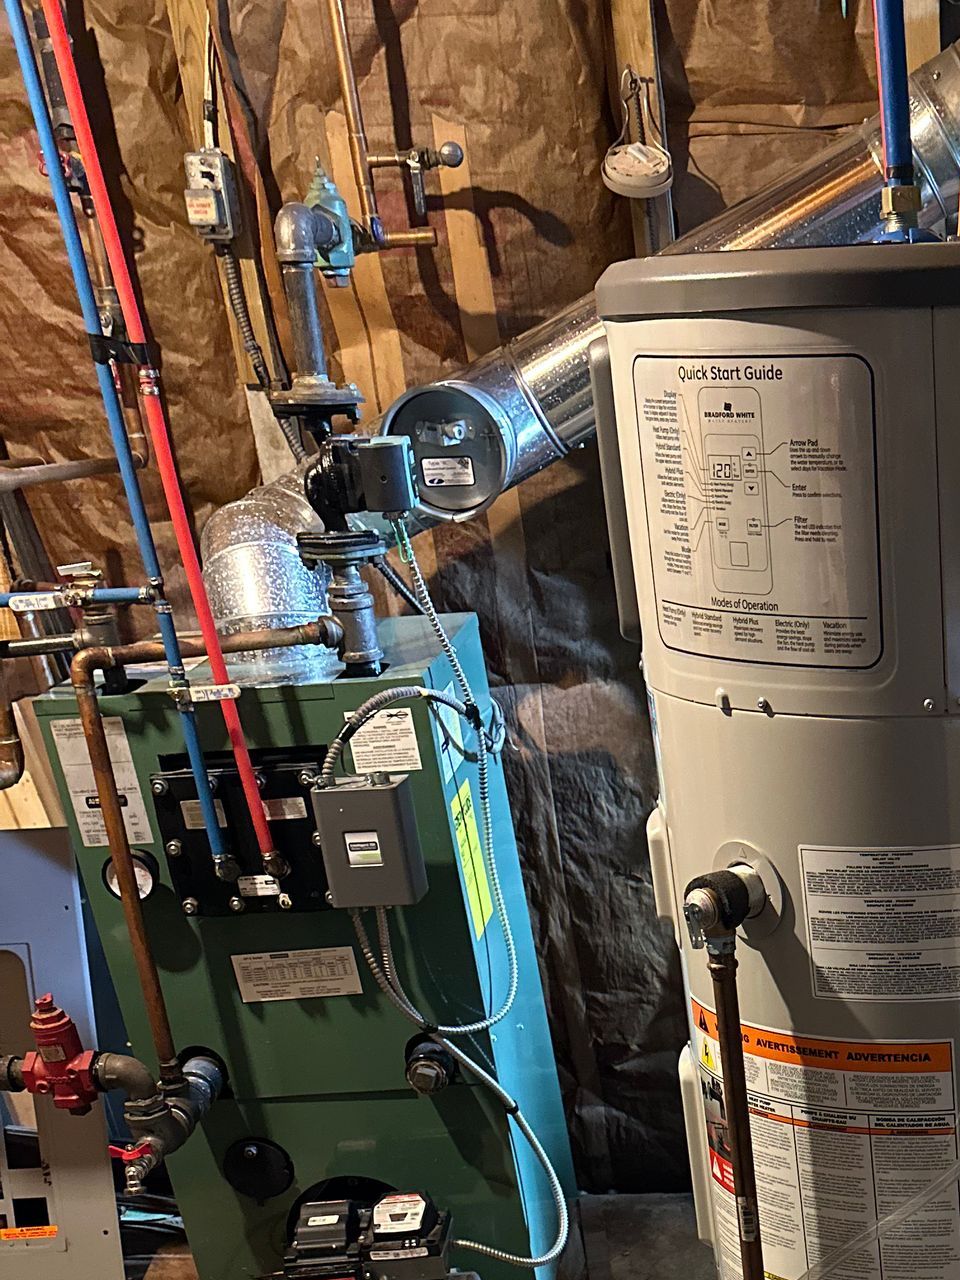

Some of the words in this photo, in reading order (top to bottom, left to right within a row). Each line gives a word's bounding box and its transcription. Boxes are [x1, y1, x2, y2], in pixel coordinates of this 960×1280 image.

[678, 365, 708, 382] Quick
[710, 366, 742, 380] Start
[744, 364, 783, 380] Guide
[704, 411, 734, 419] BRADFORD
[790, 438, 806, 447] Arrow
[807, 438, 818, 447] Pad
[713, 463, 731, 478] 120
[792, 483, 807, 491] Enter
[794, 515, 808, 523] Filter
[711, 596, 732, 608] Modes
[733, 598, 741, 609] of
[742, 599, 779, 612] Operation
[732, 616, 748, 625] Hybrid
[749, 617, 759, 625] Plus
[775, 619, 793, 628] Electric
[794, 620, 810, 630] (Only)
[822, 621, 847, 629] Vacation
[756, 1038, 840, 1060] AVERTISSEMENT
[846, 1051, 932, 1062] ADVERTENCIA
